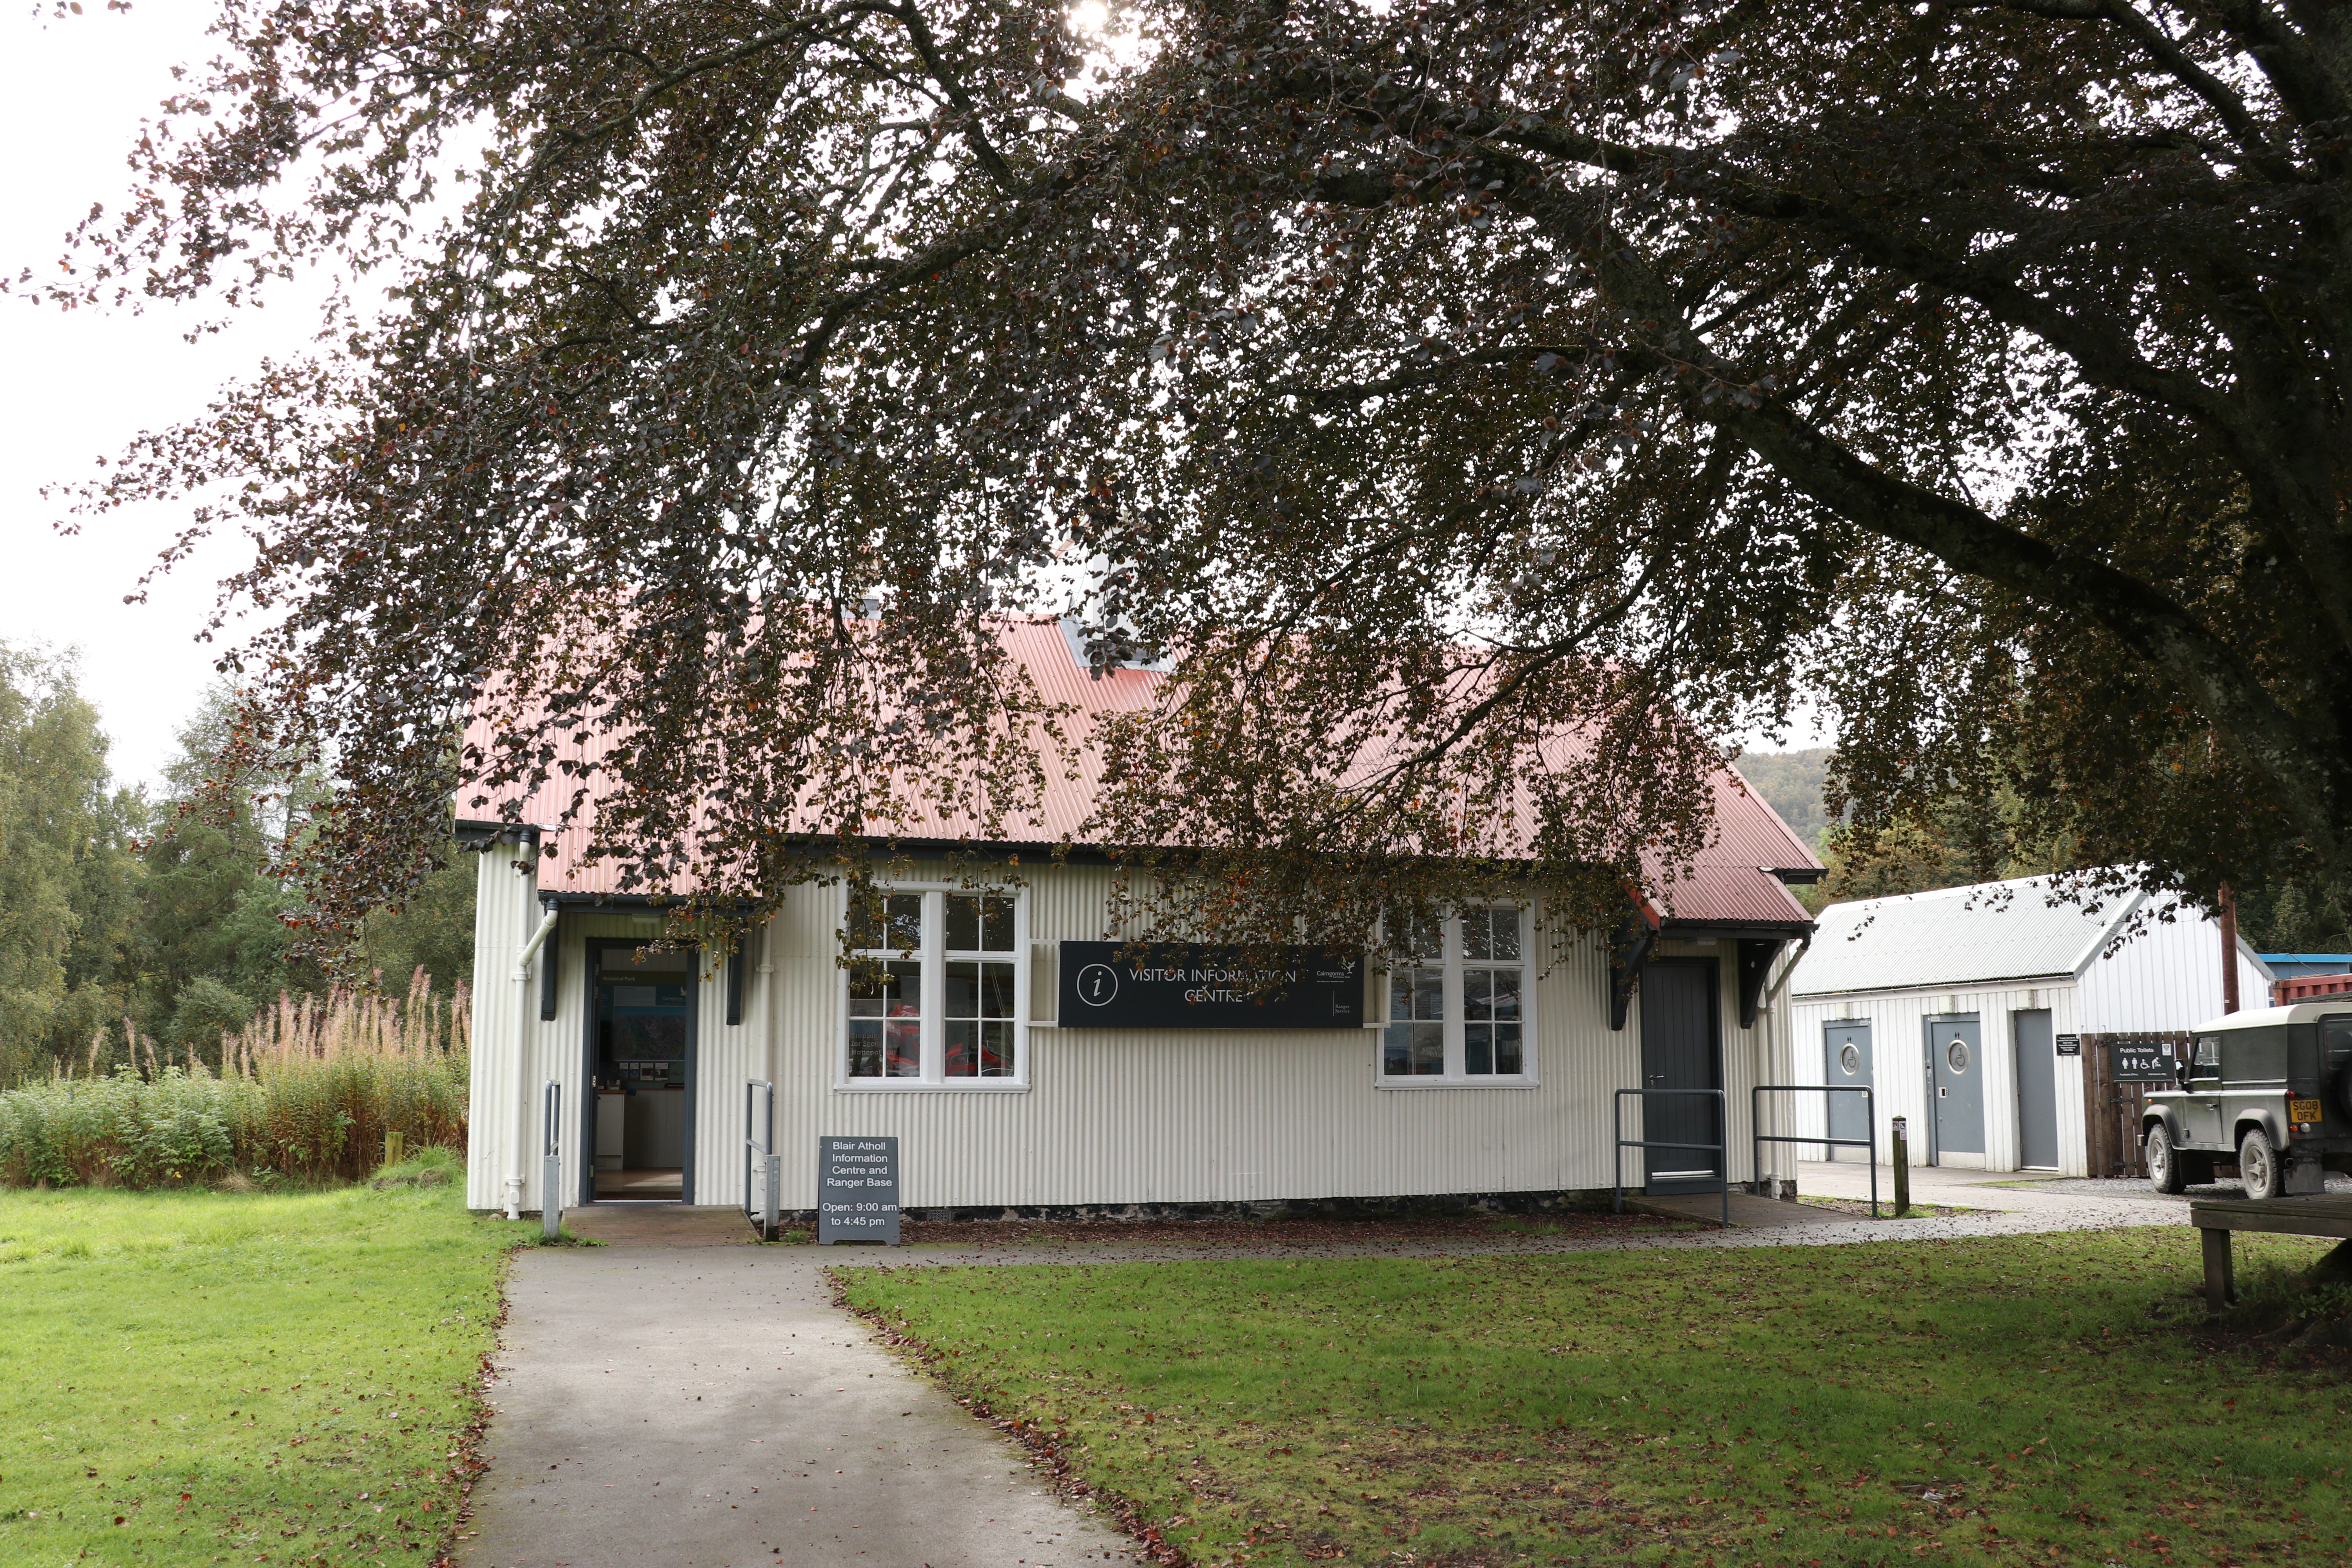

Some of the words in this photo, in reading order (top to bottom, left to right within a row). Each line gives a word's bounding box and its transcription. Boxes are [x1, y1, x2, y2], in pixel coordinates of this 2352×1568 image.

[1129, 968, 1186, 982] VISITOR
[1184, 989, 1243, 1002] CENTRE
[2293, 1101, 2318, 1110] SG08
[2297, 1111, 2316, 1120] OFK
[833, 1141, 855, 1150] Blair
[857, 1141, 886, 1151] Atholl
[832, 1153, 888, 1163] Information
[832, 1165, 866, 1174] Centre
[869, 1165, 887, 1174] and
[827, 1178, 864, 1189] Ranger
[867, 1178, 893, 1187] Base
[822, 1202, 853, 1213] Open:
[856, 1202, 878, 1212] 9:00
[831, 1217, 841, 1226] to
[844, 1216, 866, 1226] 4:45
[869, 1218, 885, 1228] pm
